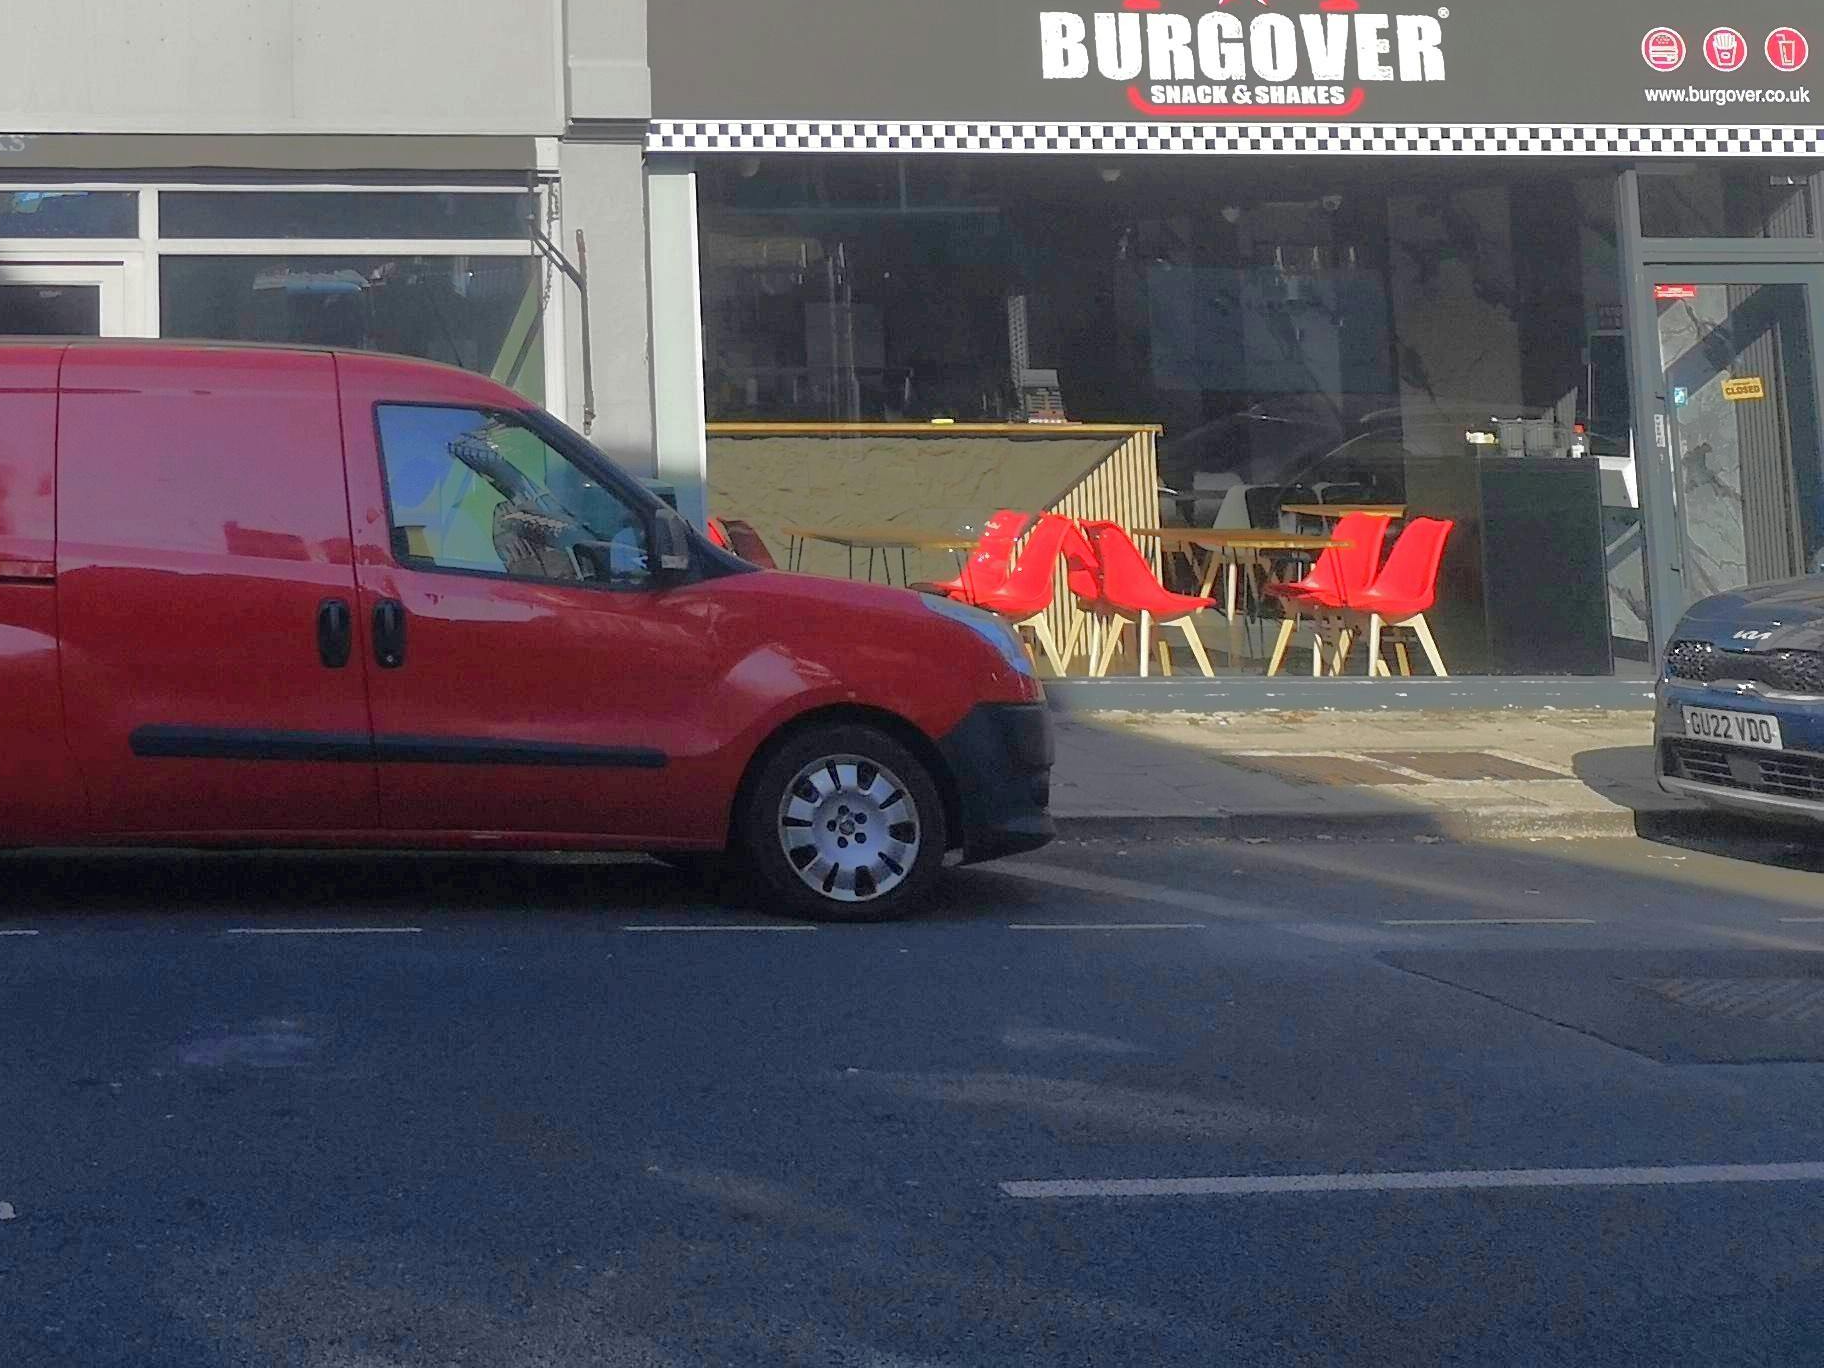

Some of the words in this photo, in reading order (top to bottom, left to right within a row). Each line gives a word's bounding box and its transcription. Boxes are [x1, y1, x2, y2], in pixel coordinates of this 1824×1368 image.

[1150, 85, 1228, 104] SNACK
[1231, 84, 1252, 105] &
[1254, 85, 1345, 105] SHAKES
[1644, 85, 1811, 106] www.burgover.co.uk
[1725, 385, 1761, 395] CLOSED
[1691, 712, 1733, 738] GU22
[1735, 716, 1772, 744] VDO
